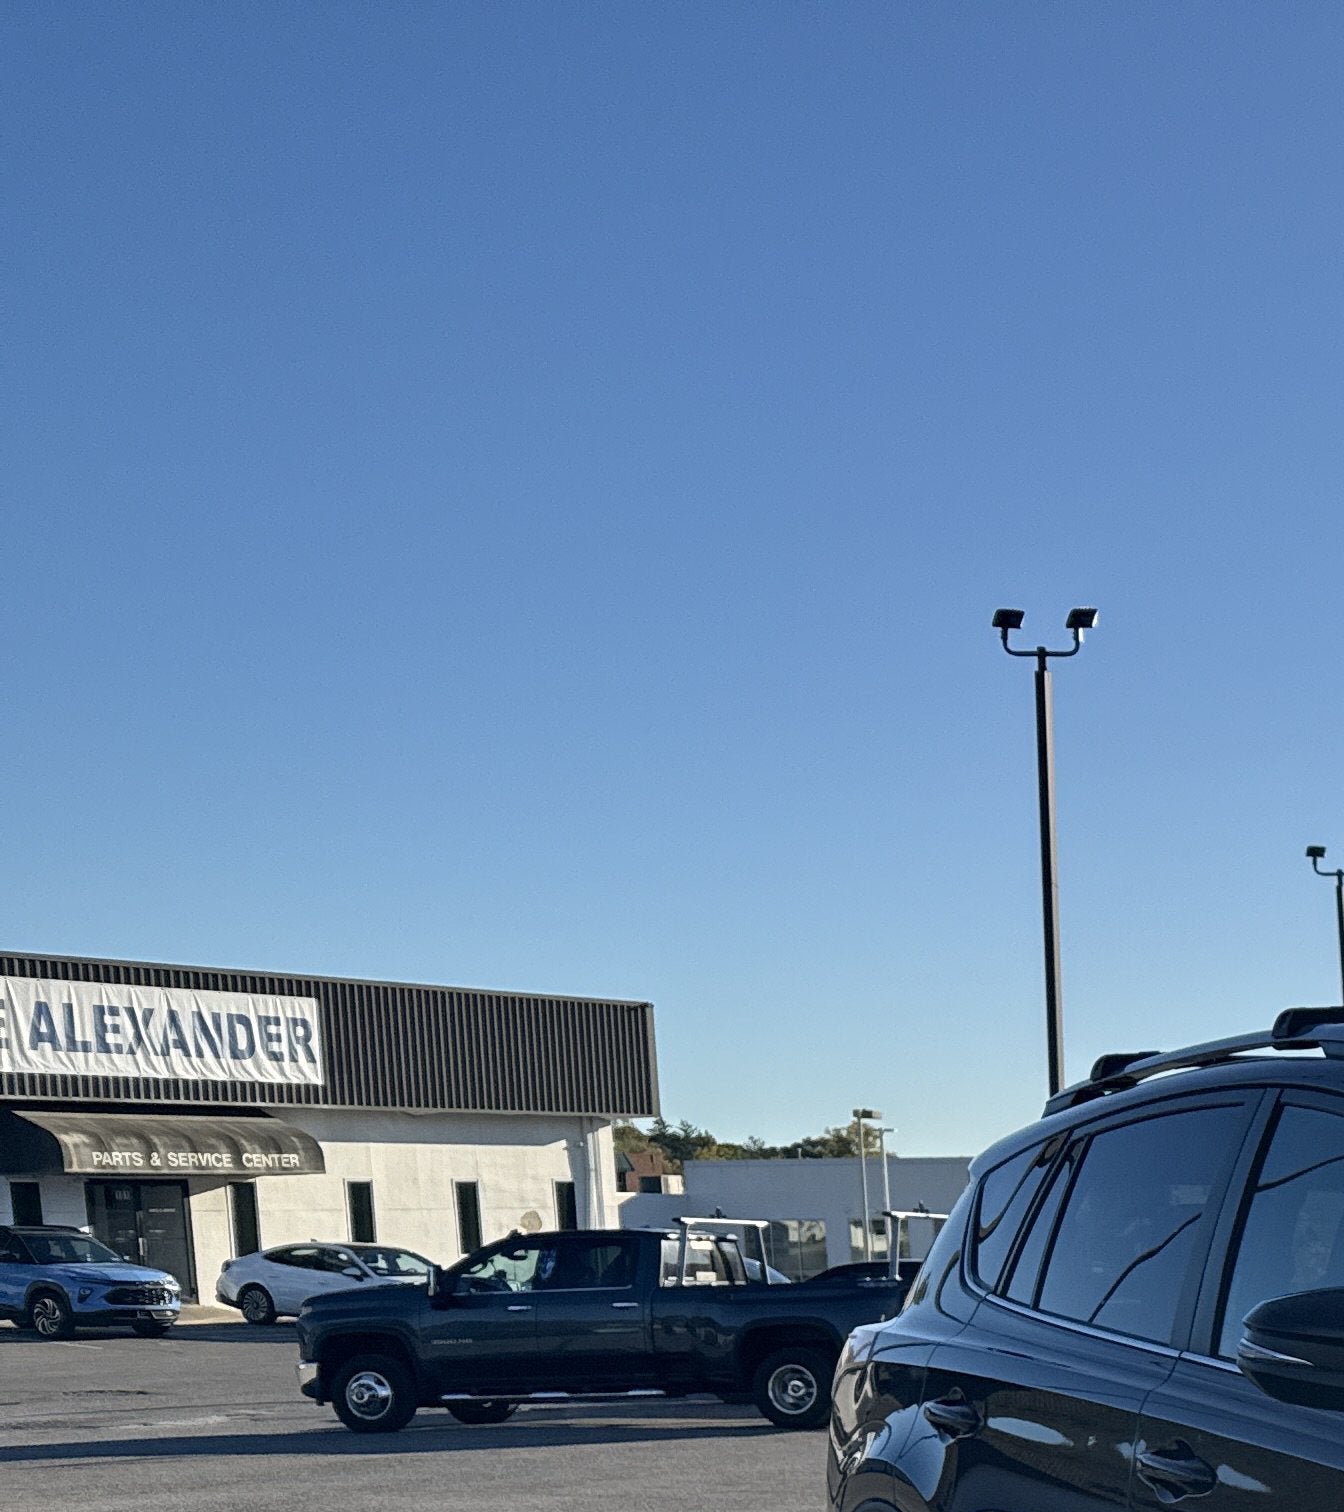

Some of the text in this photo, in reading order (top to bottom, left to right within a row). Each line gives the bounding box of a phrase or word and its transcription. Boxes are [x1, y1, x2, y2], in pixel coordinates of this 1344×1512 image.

[28, 1000, 317, 1064] ALEXANDER
[92, 1151, 301, 1168] PARTS & SERVICE CENTER
